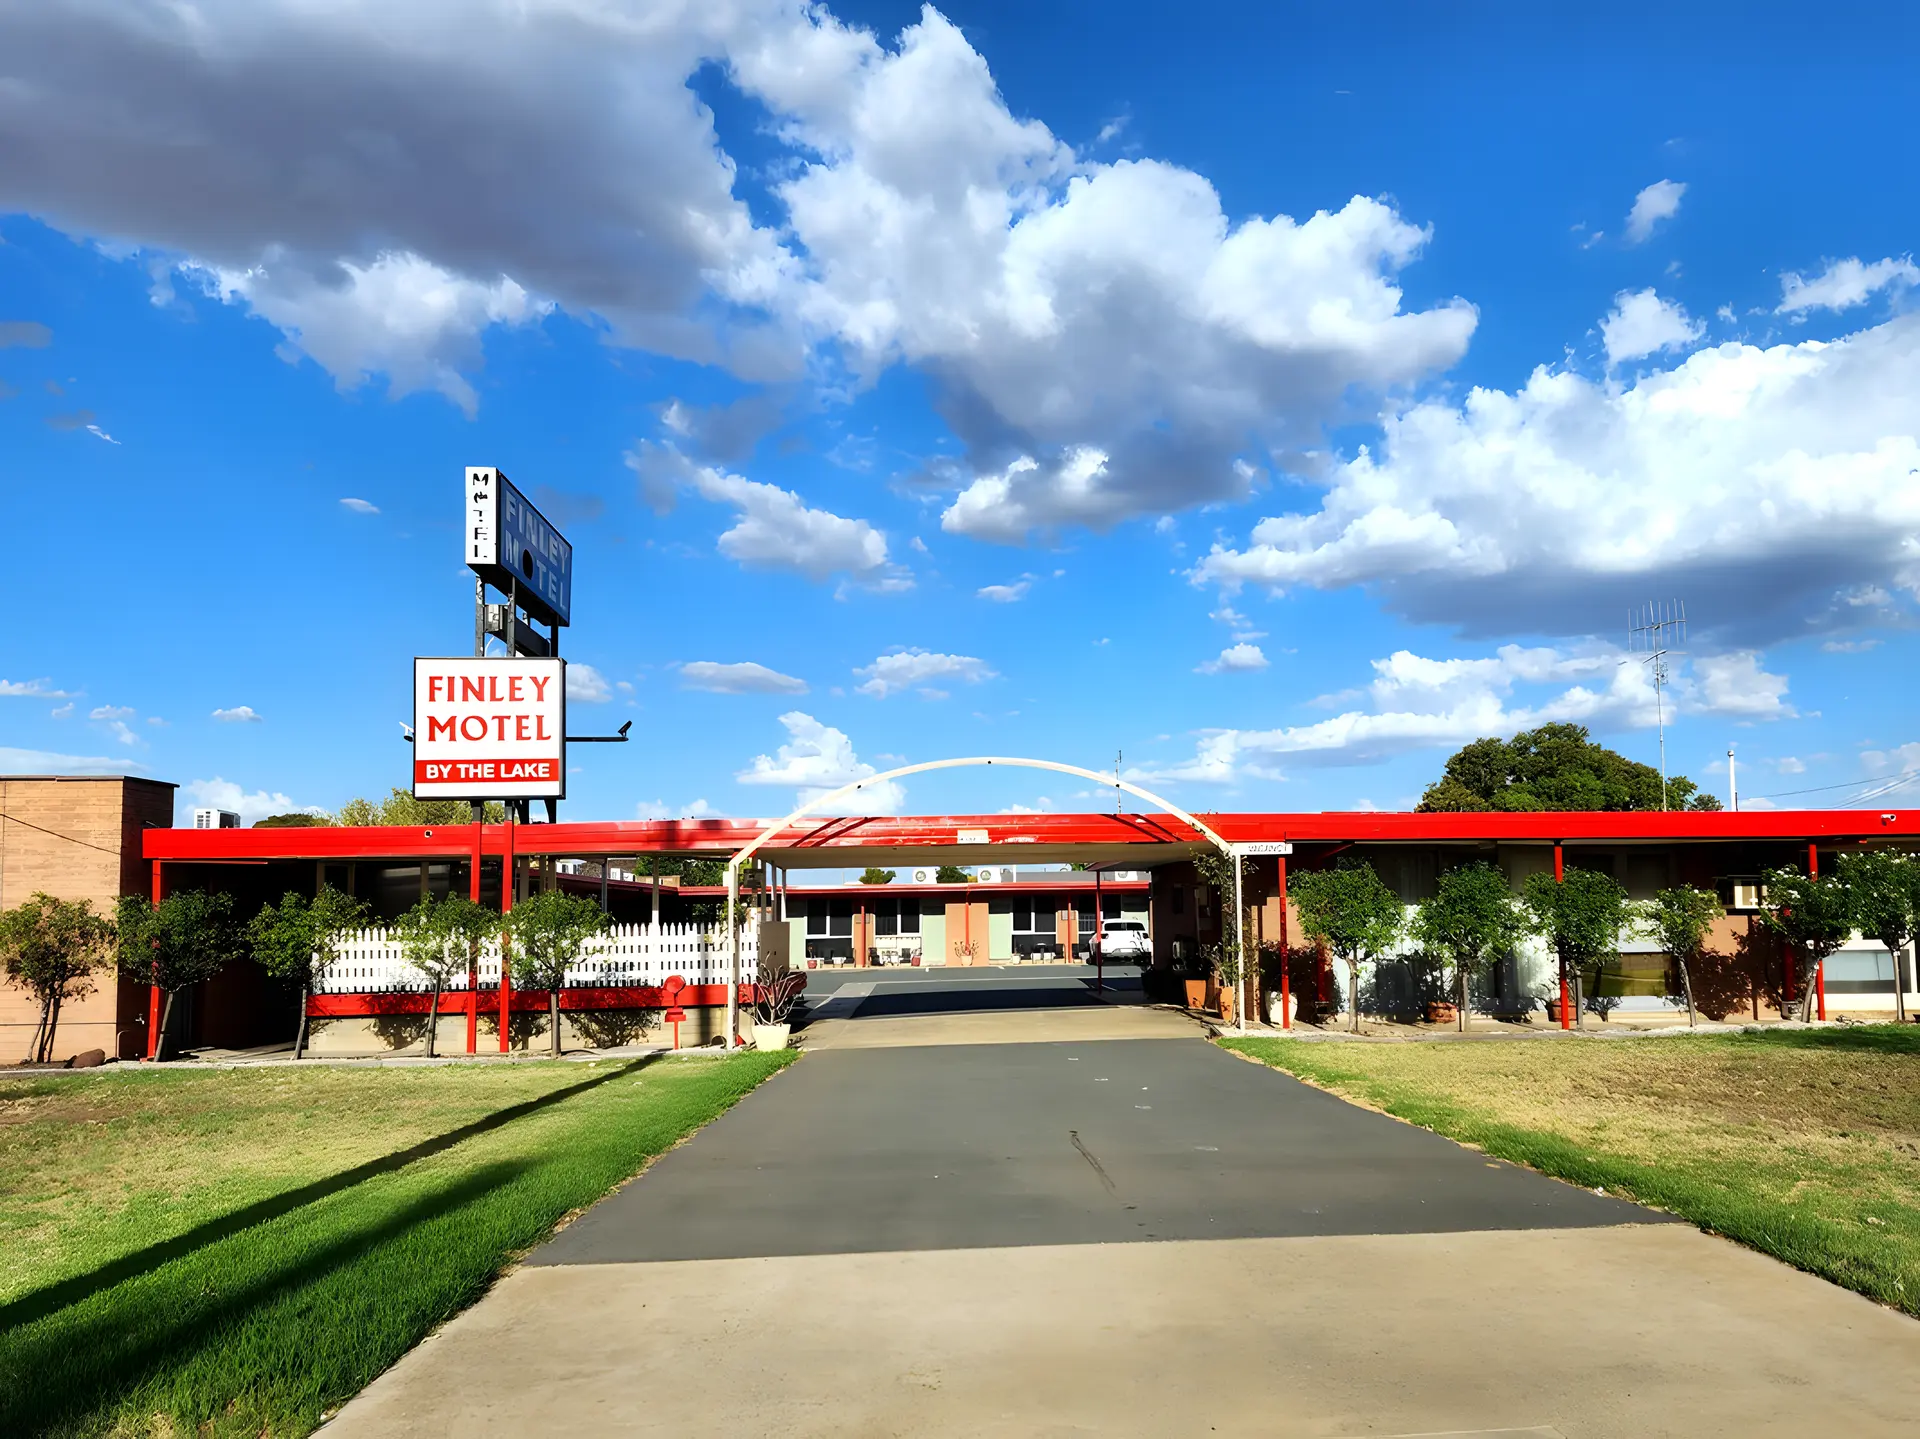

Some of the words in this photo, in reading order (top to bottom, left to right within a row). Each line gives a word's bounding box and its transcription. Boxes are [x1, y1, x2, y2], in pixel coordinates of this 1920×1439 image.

[505, 490, 568, 574] FINLEY
[428, 675, 551, 702] FINLEY
[426, 714, 552, 742] MOTEL
[426, 764, 452, 779] BY
[456, 763, 495, 779] THE
[500, 762, 550, 778] LAKE
